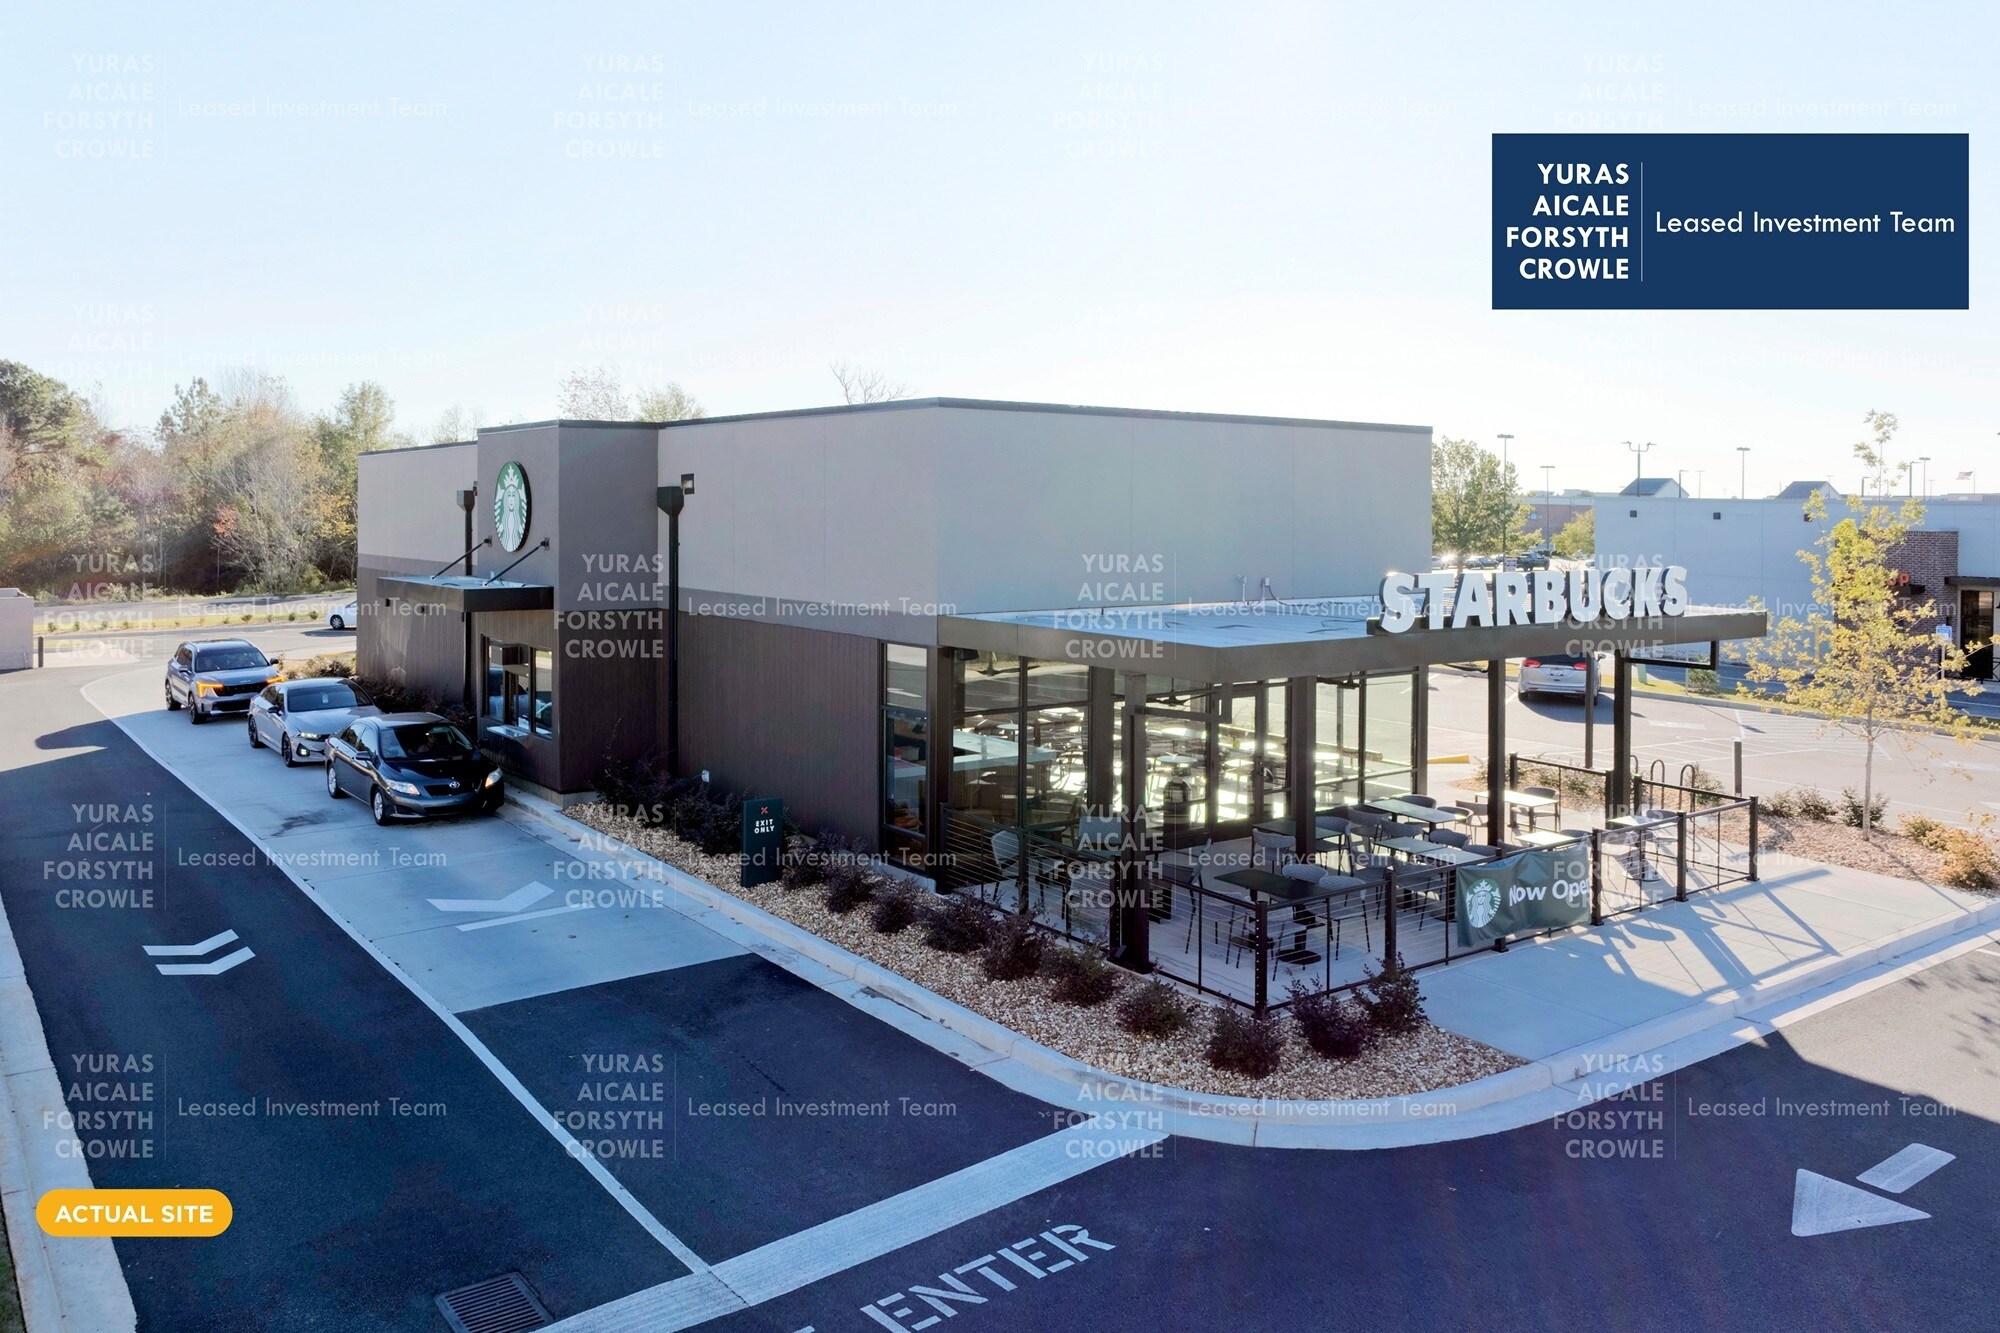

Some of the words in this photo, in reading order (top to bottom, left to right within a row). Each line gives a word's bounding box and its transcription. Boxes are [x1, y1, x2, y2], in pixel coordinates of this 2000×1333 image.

[1380, 566, 1688, 634] STARBUCKS
[754, 825, 775, 834] ONLY
[756, 819, 773, 827] EXIT
[1509, 884, 1547, 907] Now
[860, 1224, 1115, 1333] ENTER
